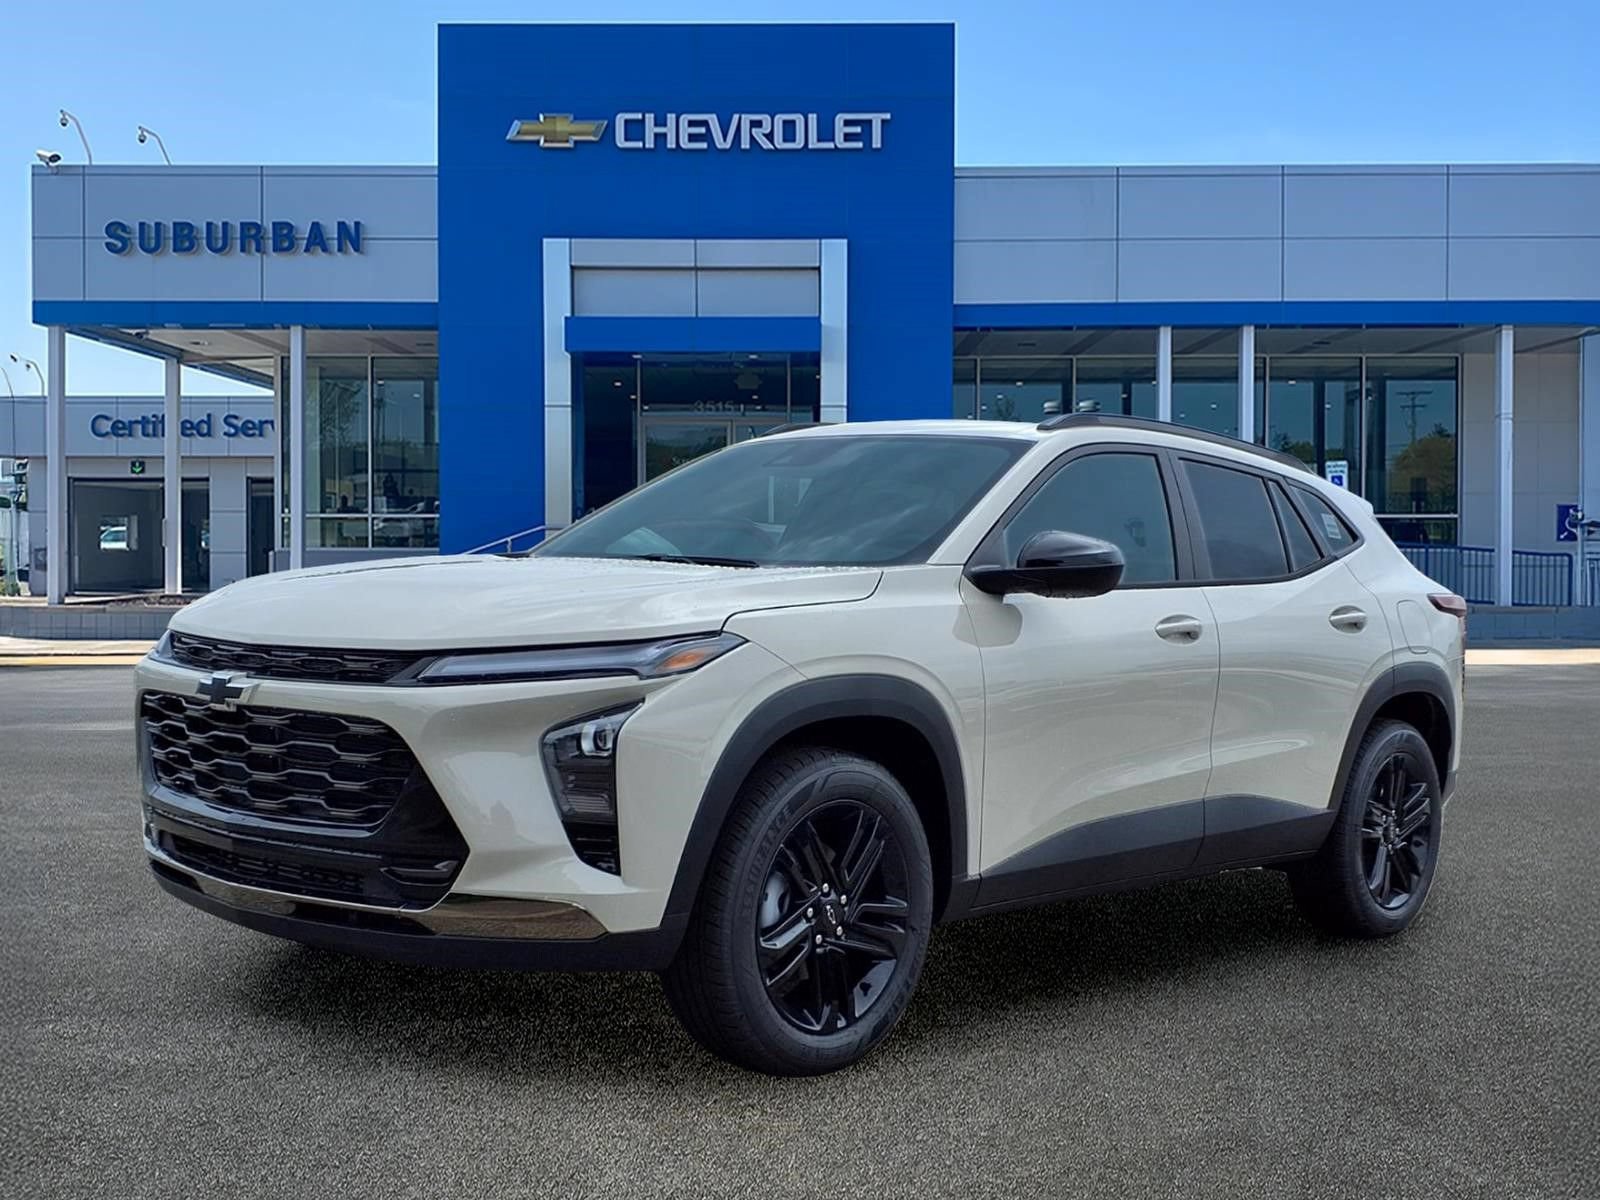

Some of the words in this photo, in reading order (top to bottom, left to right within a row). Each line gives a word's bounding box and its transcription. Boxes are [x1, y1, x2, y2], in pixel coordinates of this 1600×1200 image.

[615, 112, 891, 150] CHEVROLET
[104, 220, 363, 254] SUBURBAN
[90, 413, 213, 438] Certifed
